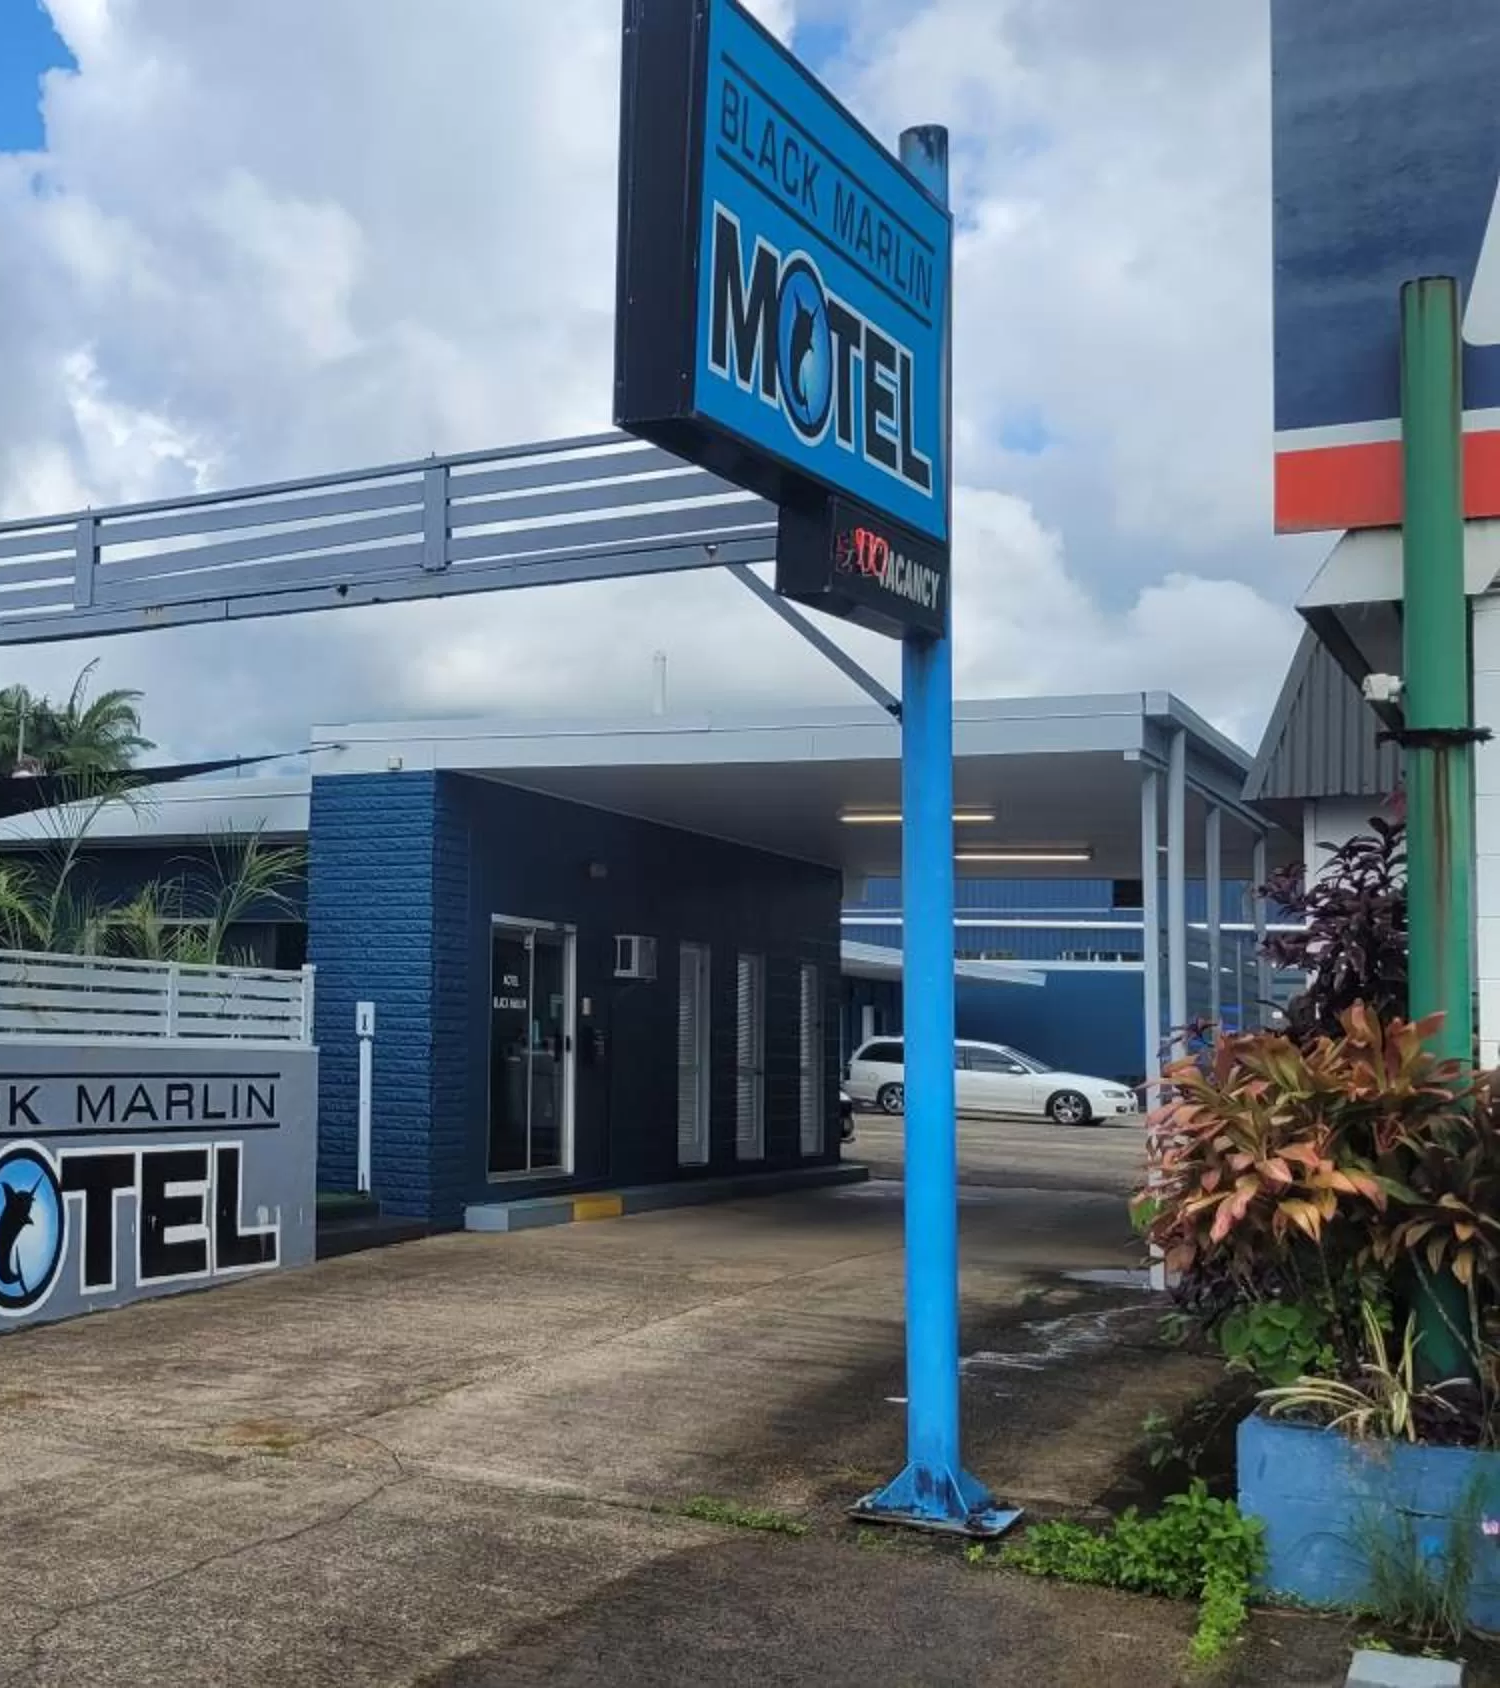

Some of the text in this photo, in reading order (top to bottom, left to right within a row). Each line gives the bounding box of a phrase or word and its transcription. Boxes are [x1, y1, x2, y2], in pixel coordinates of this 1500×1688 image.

[719, 78, 933, 310] BLACK MARLIN
[708, 199, 934, 500] MOTEL
[76, 1082, 276, 1124] MARLIN
